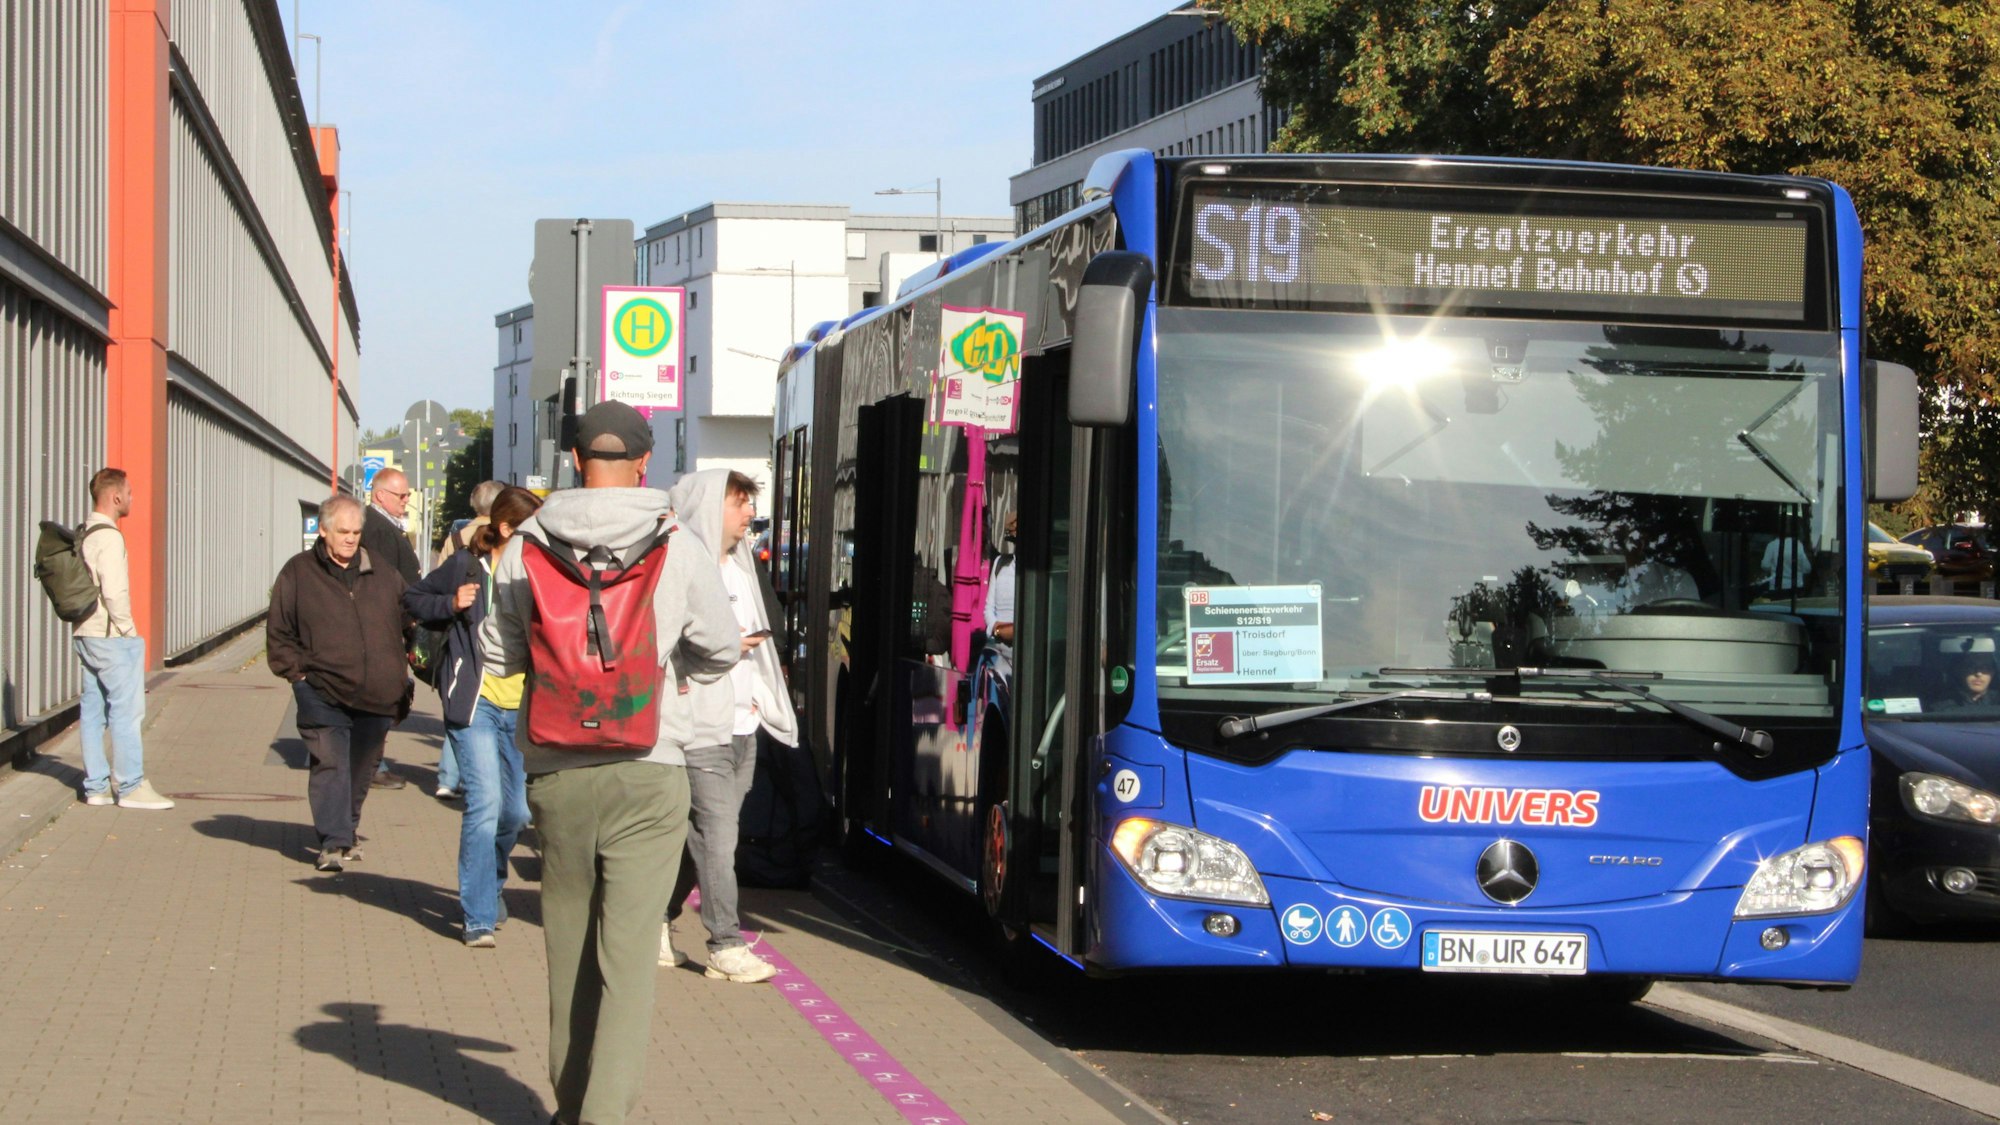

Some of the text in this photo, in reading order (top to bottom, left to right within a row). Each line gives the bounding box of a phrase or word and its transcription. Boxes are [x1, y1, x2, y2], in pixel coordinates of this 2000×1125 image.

[1431, 215, 1696, 258] Ersatzverkehr
[1196, 204, 1300, 282] S19
[1414, 253, 1522, 289] Hennef
[1536, 257, 1664, 294] Bahnhof
[631, 311, 655, 344] H
[610, 390, 673, 400] Richtung Siegen
[307, 518, 316, 531] P
[1191, 593, 1207, 603] DB
[1204, 606, 1303, 615] Schienenersatzverkehr
[1236, 616, 1272, 625] S12/S19
[1242, 630, 1286, 639] Troisdorf
[1196, 659, 1219, 667] Ersatz
[1242, 667, 1277, 676] Hennef
[1117, 778, 1135, 795] 47
[1419, 785, 1600, 827] UNIVERS
[1589, 854, 1663, 866] CITARO
[1428, 951, 1435, 961] D
[1440, 937, 1582, 965] BN UR 647
